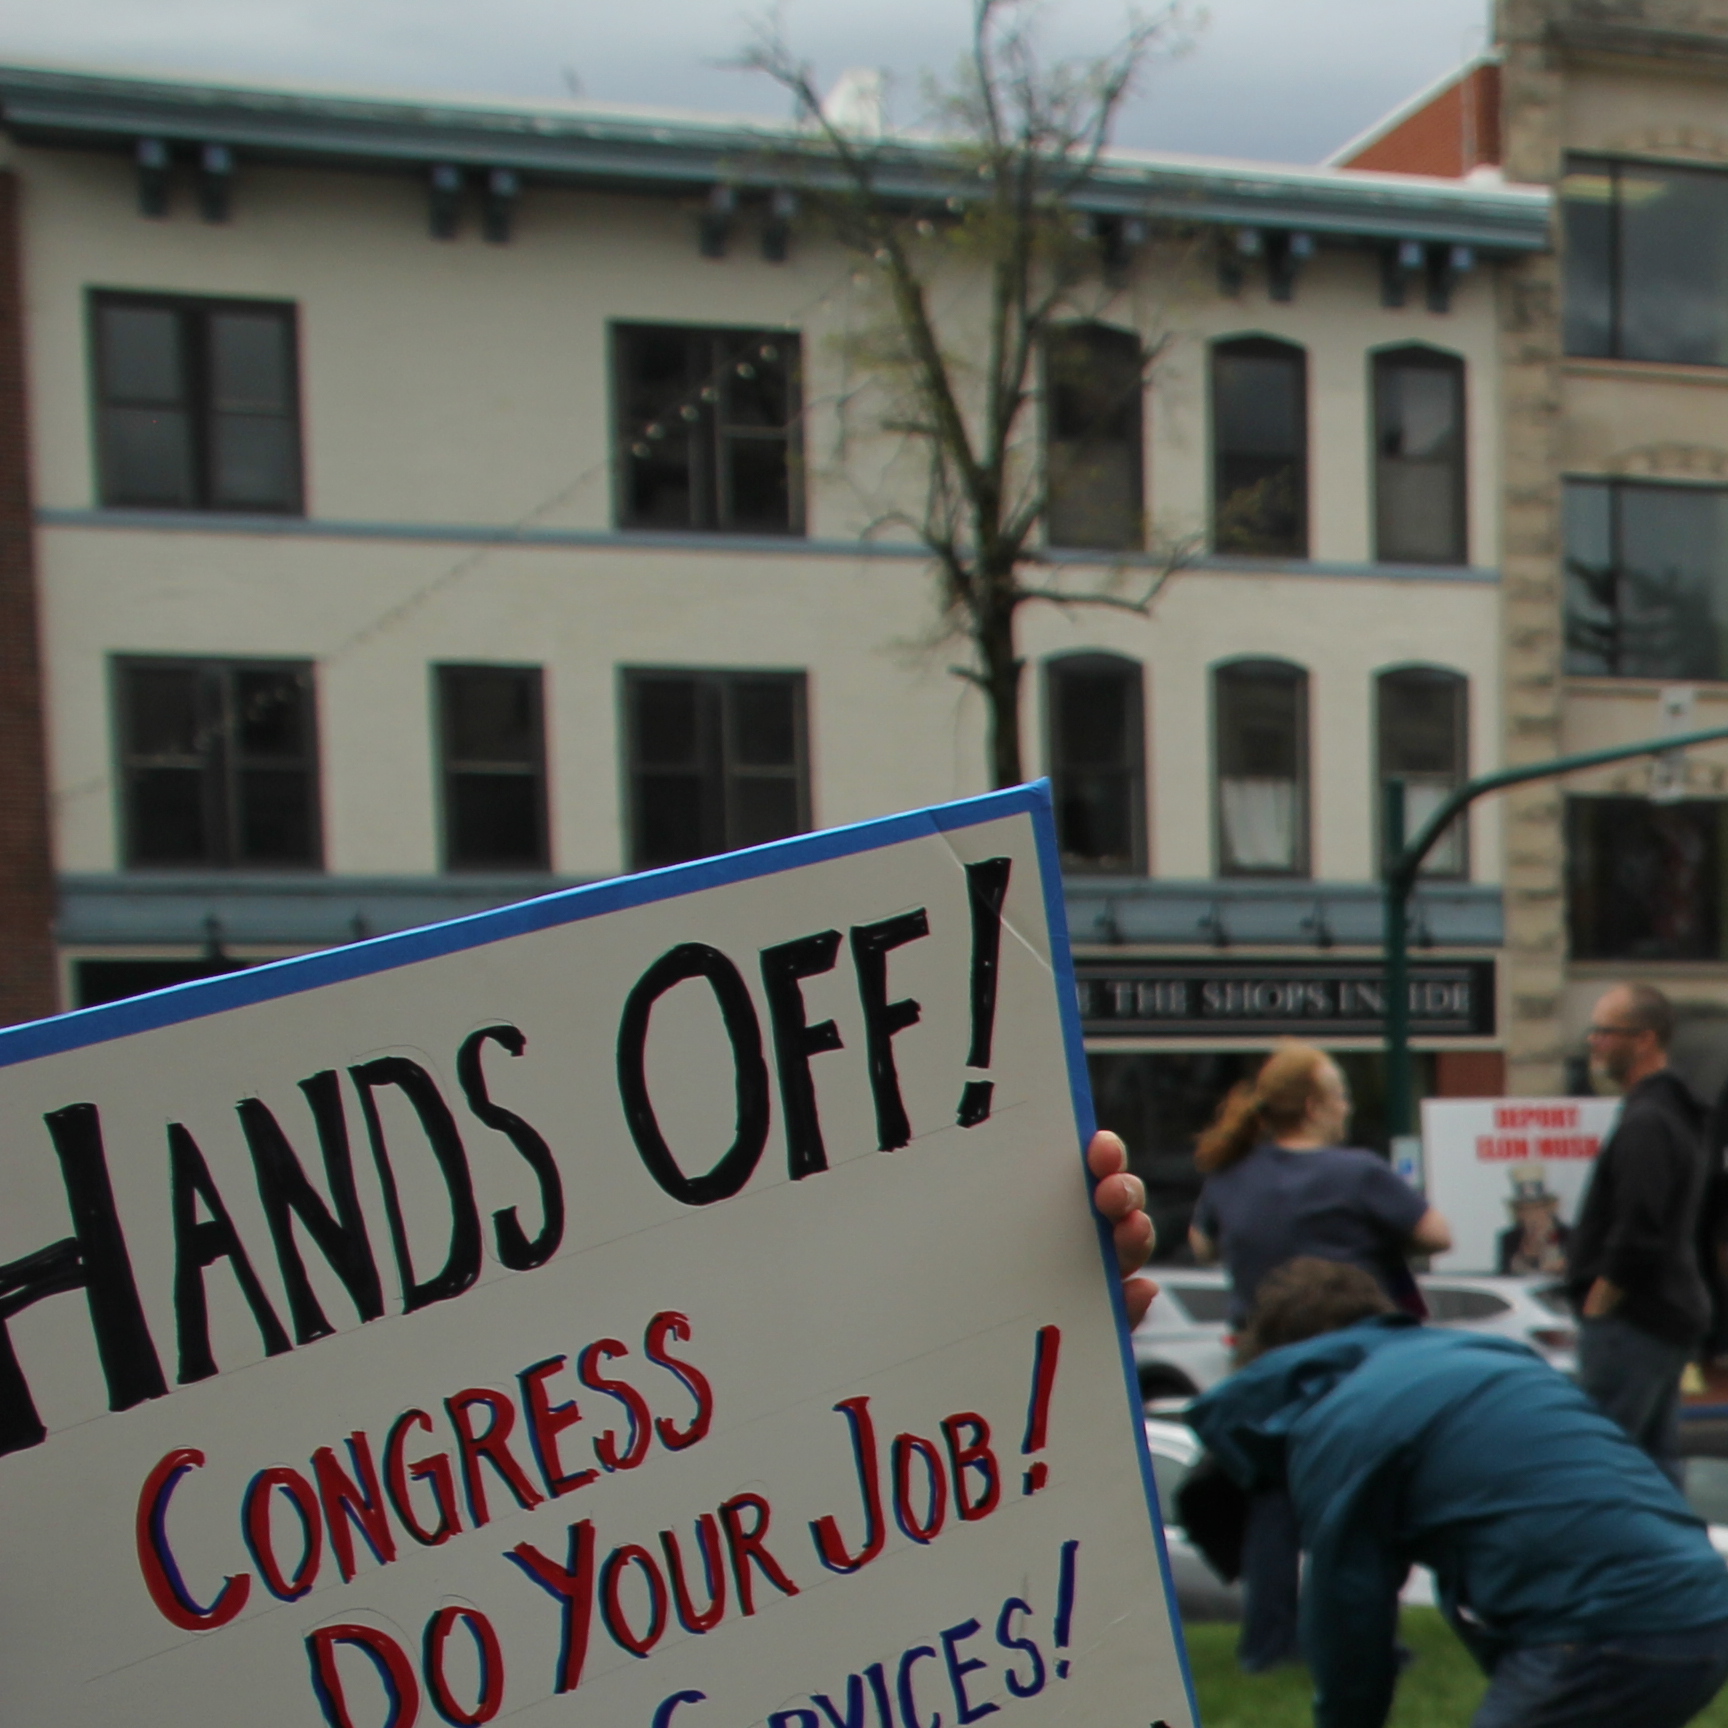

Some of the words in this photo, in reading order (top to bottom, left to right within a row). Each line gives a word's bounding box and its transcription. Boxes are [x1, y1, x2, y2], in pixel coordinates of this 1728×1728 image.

[0, 1024, 565, 1456] HANDS
[617, 857, 1012, 1207] OFF!
[1106, 980, 1187, 1016] THE
[1202, 980, 1332, 1016] SHOPS
[1338, 980, 1470, 1016] INIDE
[136, 1310, 715, 1632] CONGRESS
[505, 1492, 801, 1692] YOUR
[809, 1325, 1061, 1575] JOB!
